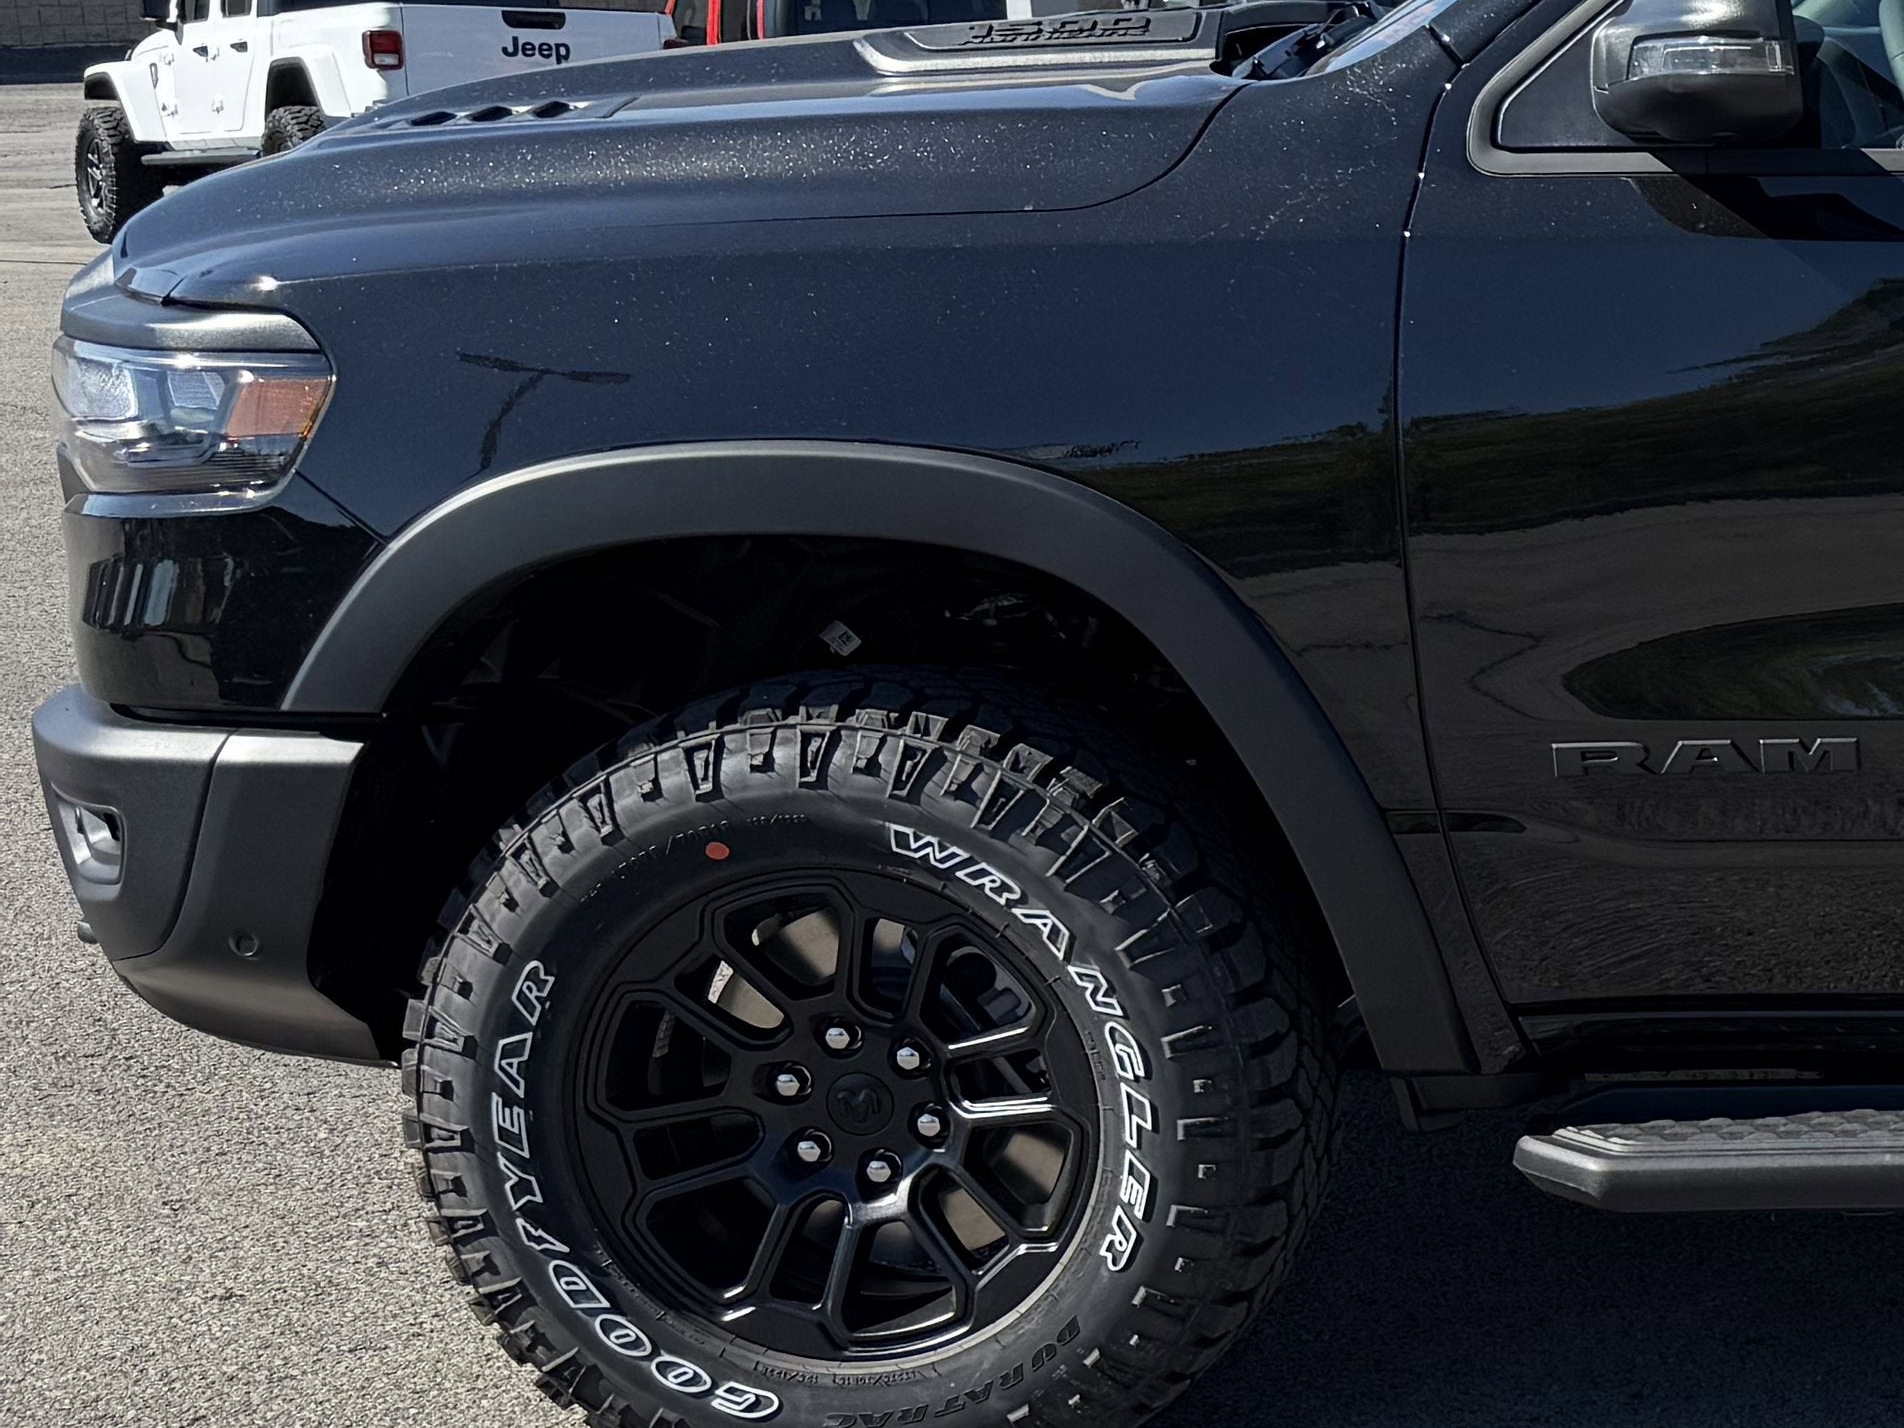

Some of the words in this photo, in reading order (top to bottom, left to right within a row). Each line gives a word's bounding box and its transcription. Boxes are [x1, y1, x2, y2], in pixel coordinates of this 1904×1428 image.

[501, 35, 571, 65] Jeep
[1551, 738, 1861, 778] RAM
[890, 824, 1154, 1272] WRANGLER
[491, 960, 780, 1419] GOODYEAR
